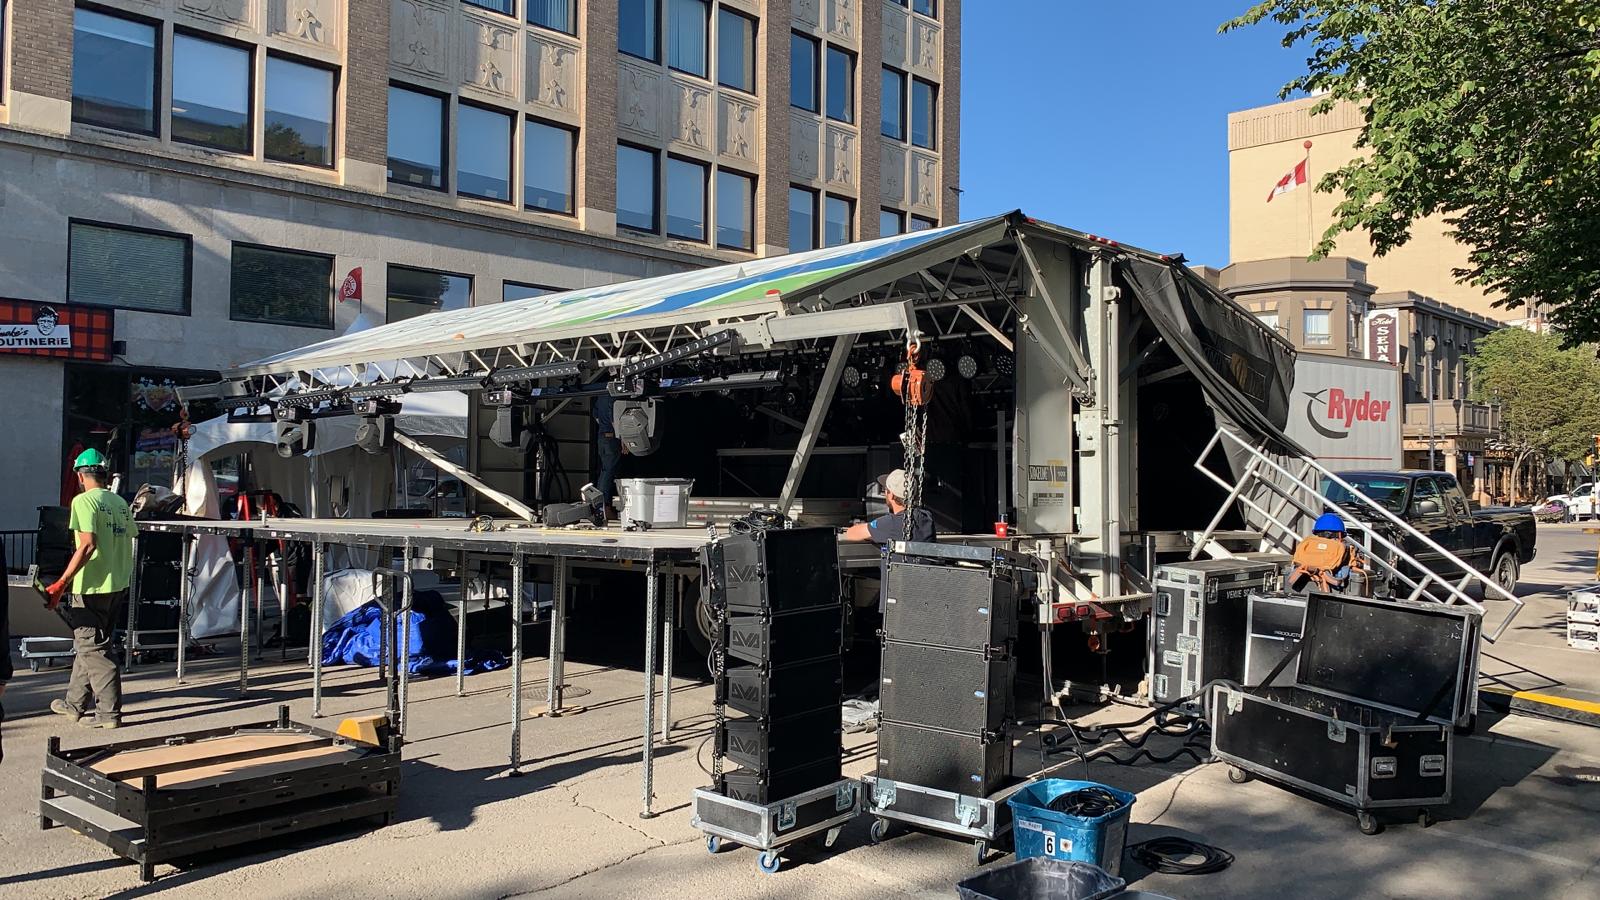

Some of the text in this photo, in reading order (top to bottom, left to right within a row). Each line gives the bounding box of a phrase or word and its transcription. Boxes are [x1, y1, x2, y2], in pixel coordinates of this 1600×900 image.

[1371, 317, 1394, 326] Hotel
[1327, 387, 1391, 428] Ryder
[1046, 837, 1053, 853] 6
